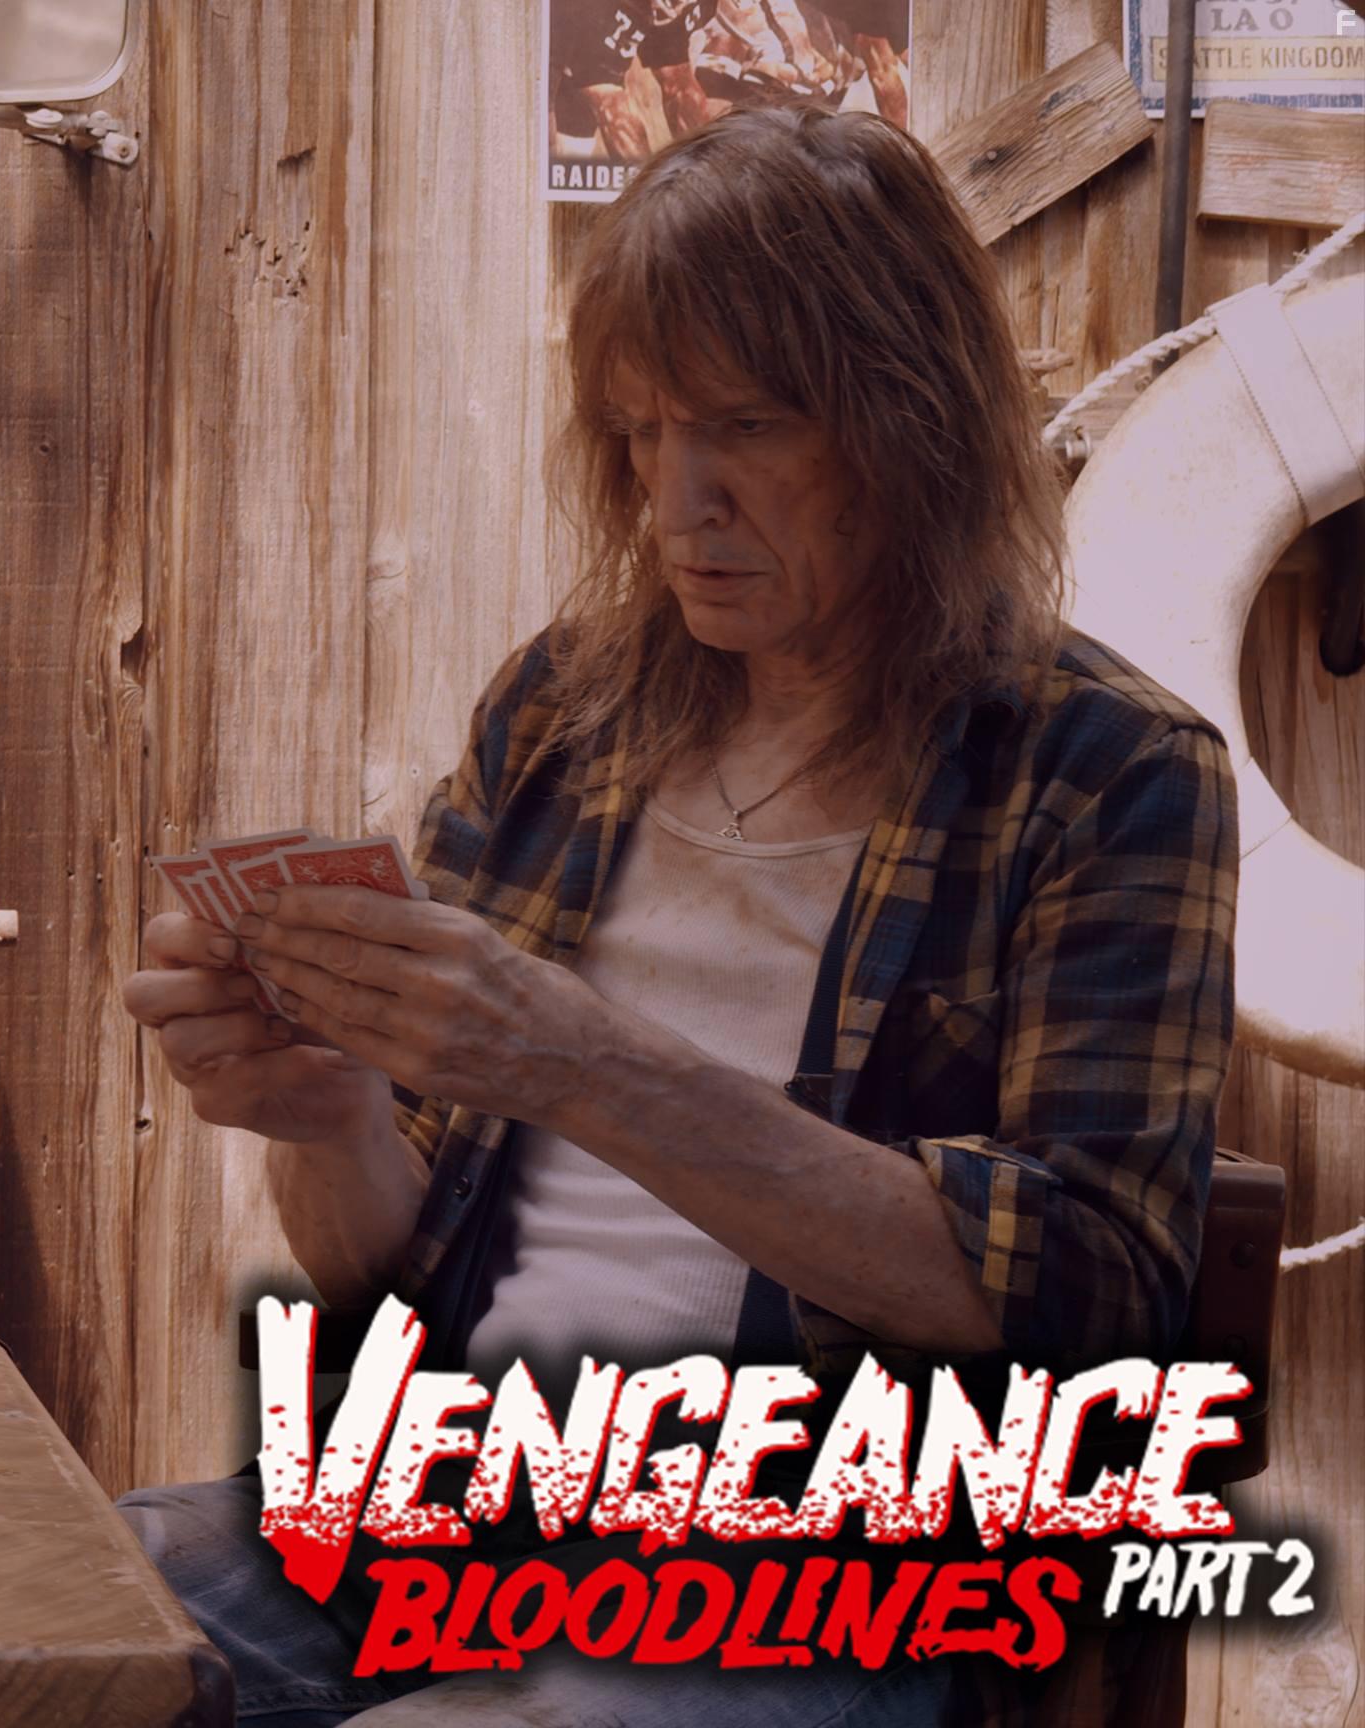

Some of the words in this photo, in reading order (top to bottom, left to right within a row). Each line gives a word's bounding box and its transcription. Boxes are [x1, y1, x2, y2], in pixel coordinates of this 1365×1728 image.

[1211, 8, 1259, 32] LA
[1158, 47, 1252, 69] SATTLE
[1260, 46, 1365, 69] KINGDOM
